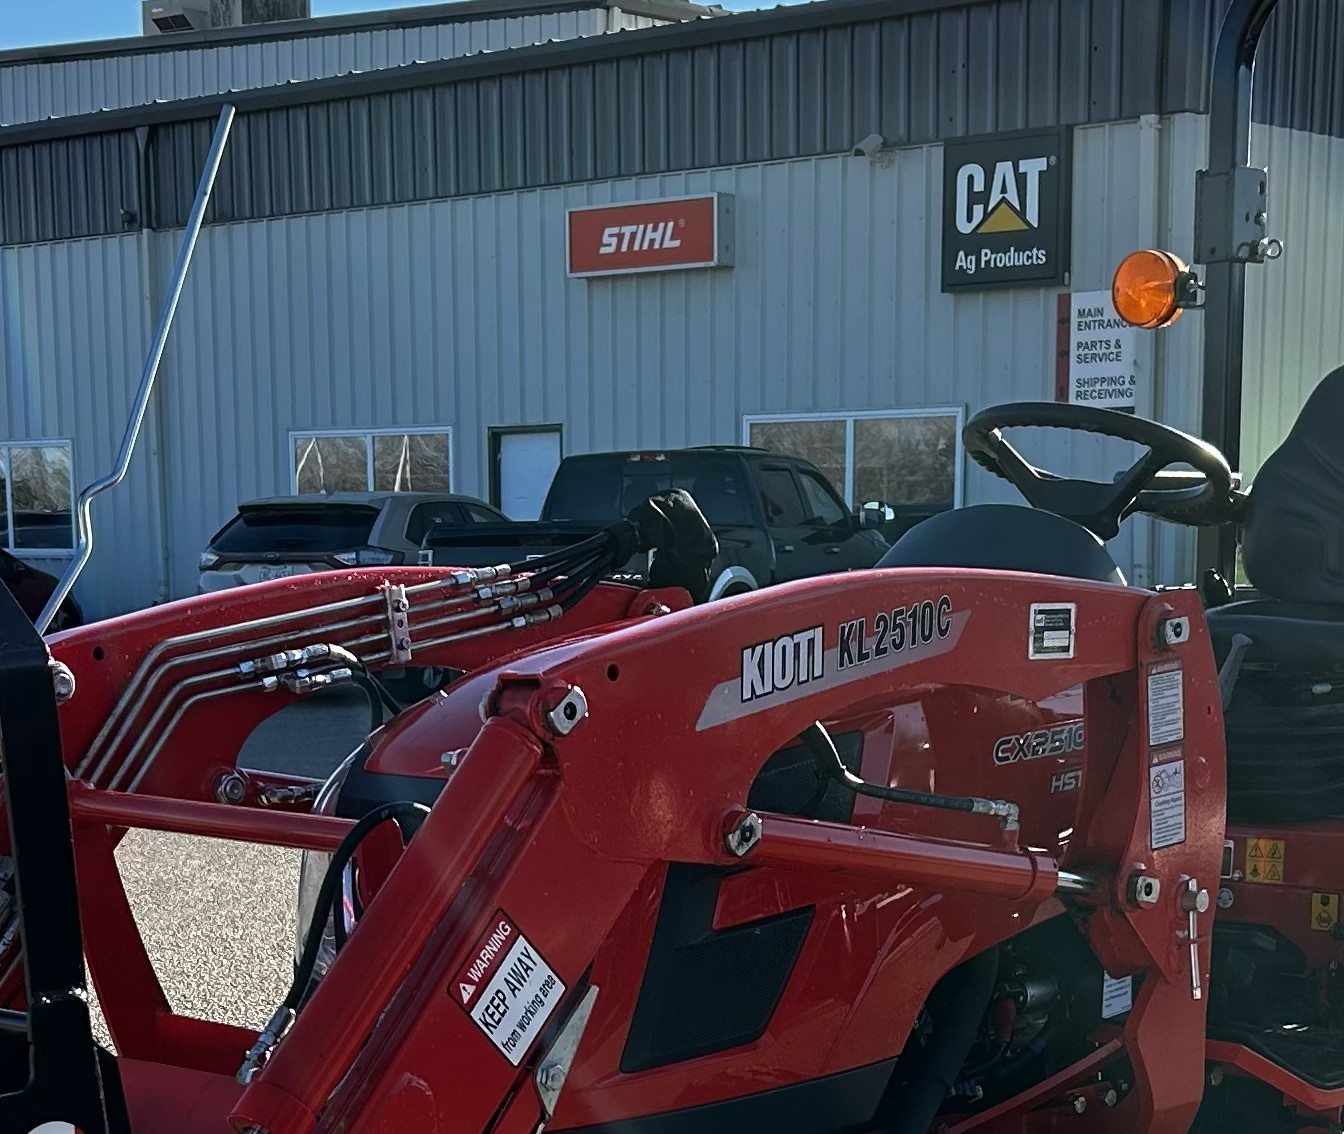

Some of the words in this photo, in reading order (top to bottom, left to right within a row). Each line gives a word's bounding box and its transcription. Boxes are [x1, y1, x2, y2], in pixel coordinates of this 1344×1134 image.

[956, 157, 1047, 234] CAT
[599, 221, 681, 254] STIHL
[955, 250, 976, 274] Ag
[981, 247, 1047, 268] Products
[1077, 307, 1104, 319] MAIN
[1076, 351, 1122, 364] SERVICE
[1077, 340, 1111, 351] PARTS
[1114, 339, 1122, 350] &
[1075, 387, 1133, 400] RECEIVING
[1076, 375, 1125, 388] SHIPPING
[1128, 374, 1136, 386] &
[741, 625, 824, 702] KIOTI
[467, 920, 512, 982] WARNING
[478, 989, 510, 1035] KEEP
[504, 946, 538, 998] AWAY
[501, 1029, 522, 1054] from
[516, 992, 546, 1032] working
[538, 974, 557, 999] area
